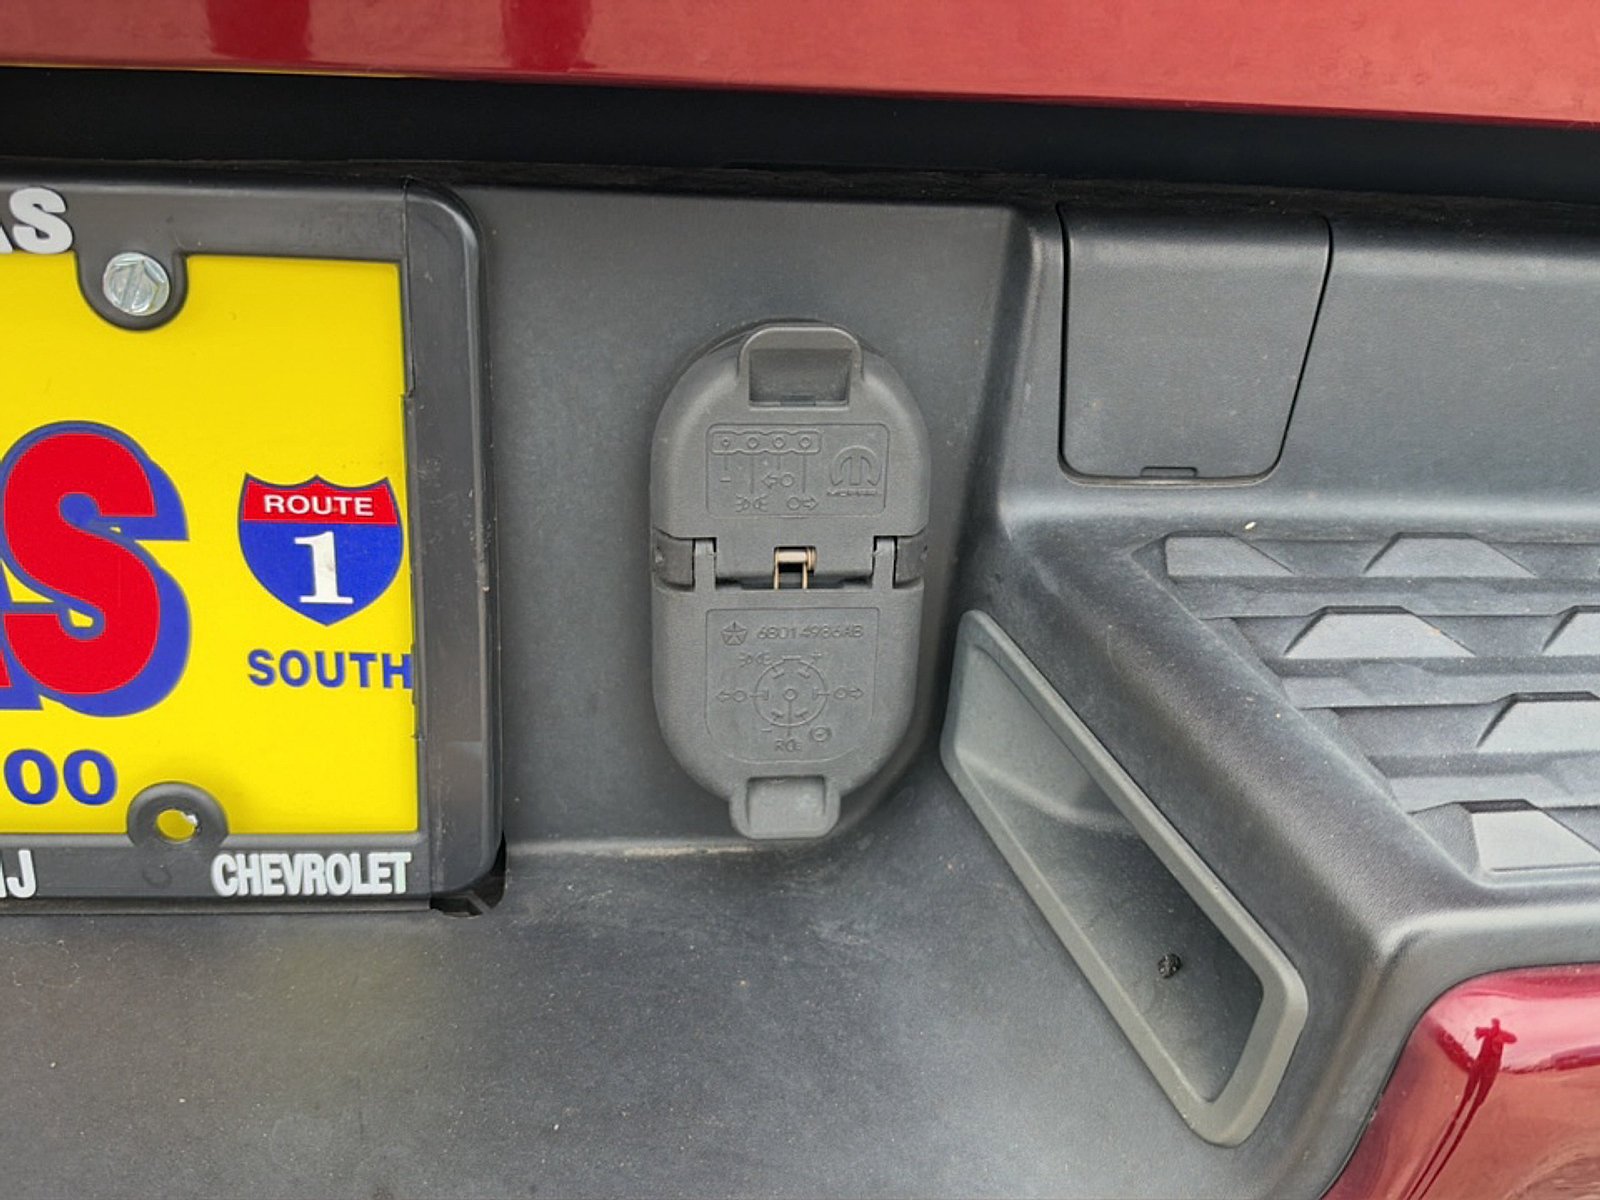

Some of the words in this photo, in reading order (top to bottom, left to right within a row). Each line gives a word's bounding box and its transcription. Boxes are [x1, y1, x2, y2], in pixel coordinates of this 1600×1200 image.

[0, 187, 73, 253] S
[264, 495, 374, 517] ROUTE
[0, 420, 191, 717] S
[294, 531, 354, 605] 1
[248, 649, 413, 689] SOUTH
[0, 849, 37, 898] J
[211, 851, 412, 896] CHEVROLET
